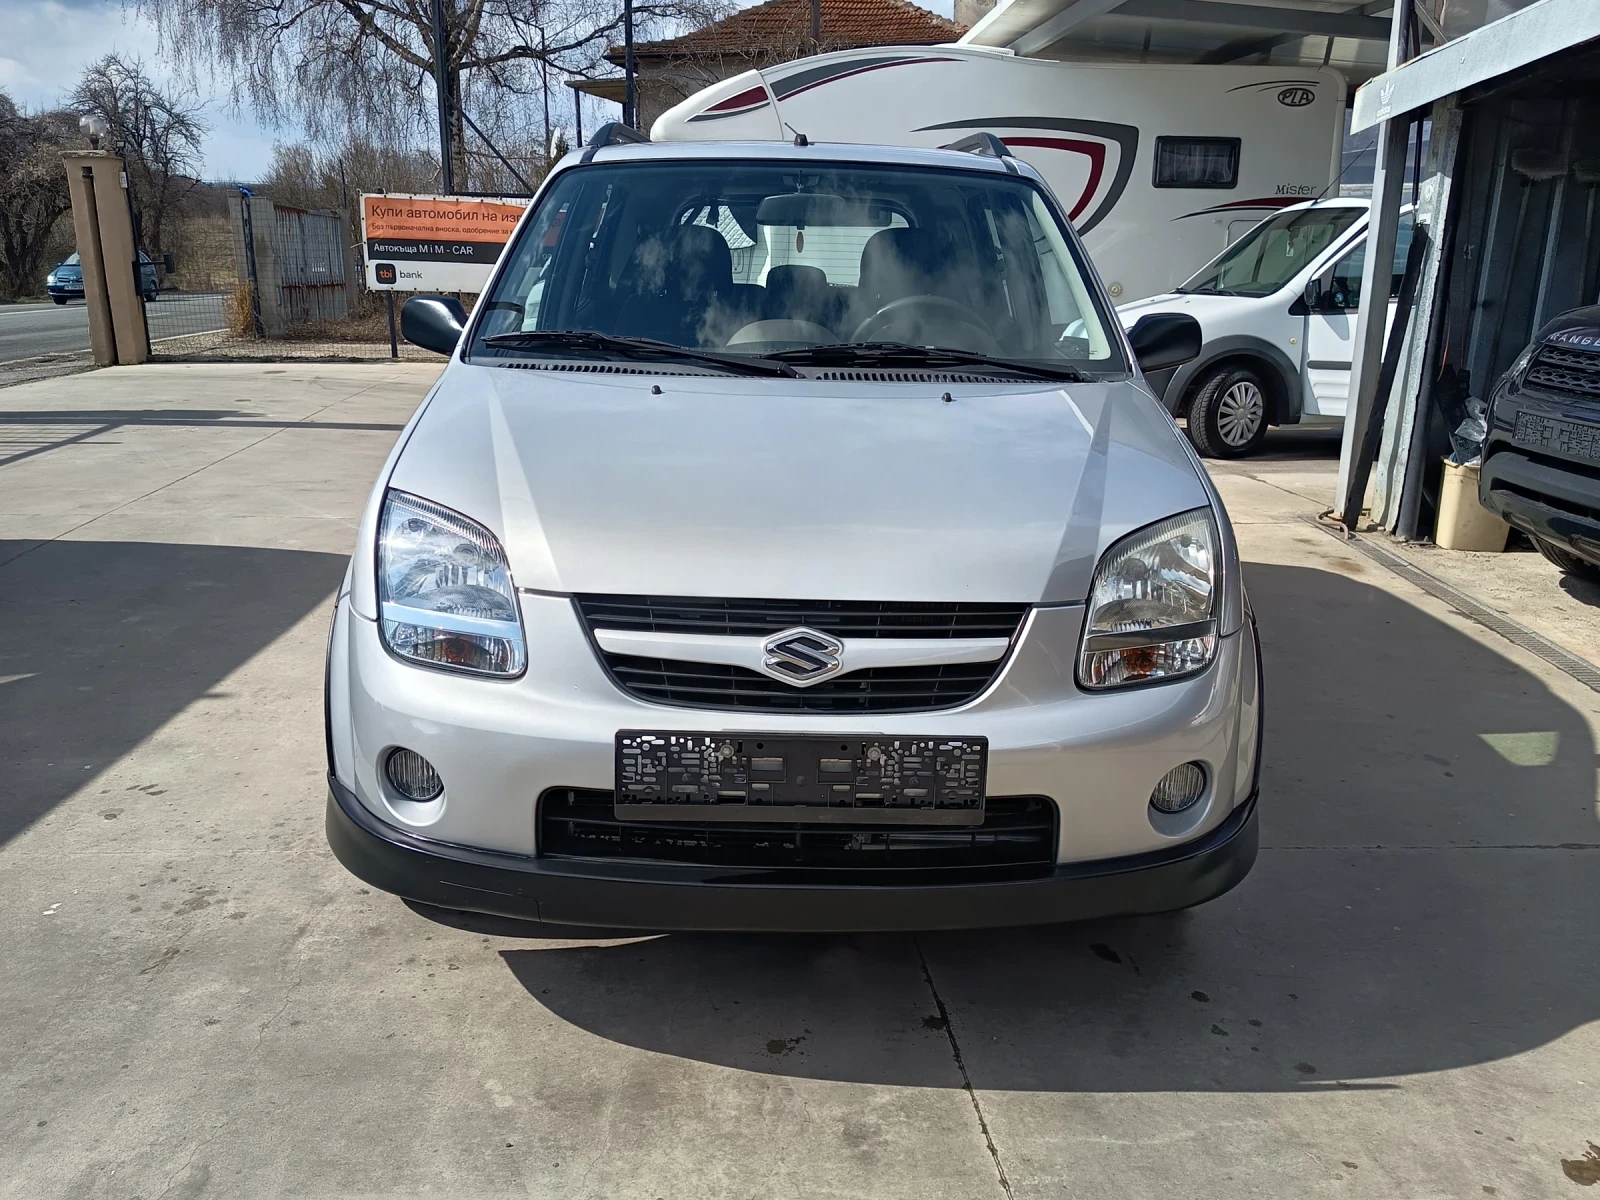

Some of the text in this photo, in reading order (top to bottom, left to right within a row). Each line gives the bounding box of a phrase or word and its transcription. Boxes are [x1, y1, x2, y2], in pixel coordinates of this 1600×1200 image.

[1281, 91, 1311, 104] PLA
[1274, 183, 1317, 195] Mister
[371, 205, 403, 219] Купи
[406, 208, 479, 220] автомобил
[482, 212, 498, 222] на
[386, 224, 434, 232] първоначална
[462, 227, 500, 235] одобрение
[373, 243, 417, 254] Автокъща
[452, 246, 474, 255] CAR
[379, 269, 423, 279] tbi bank
